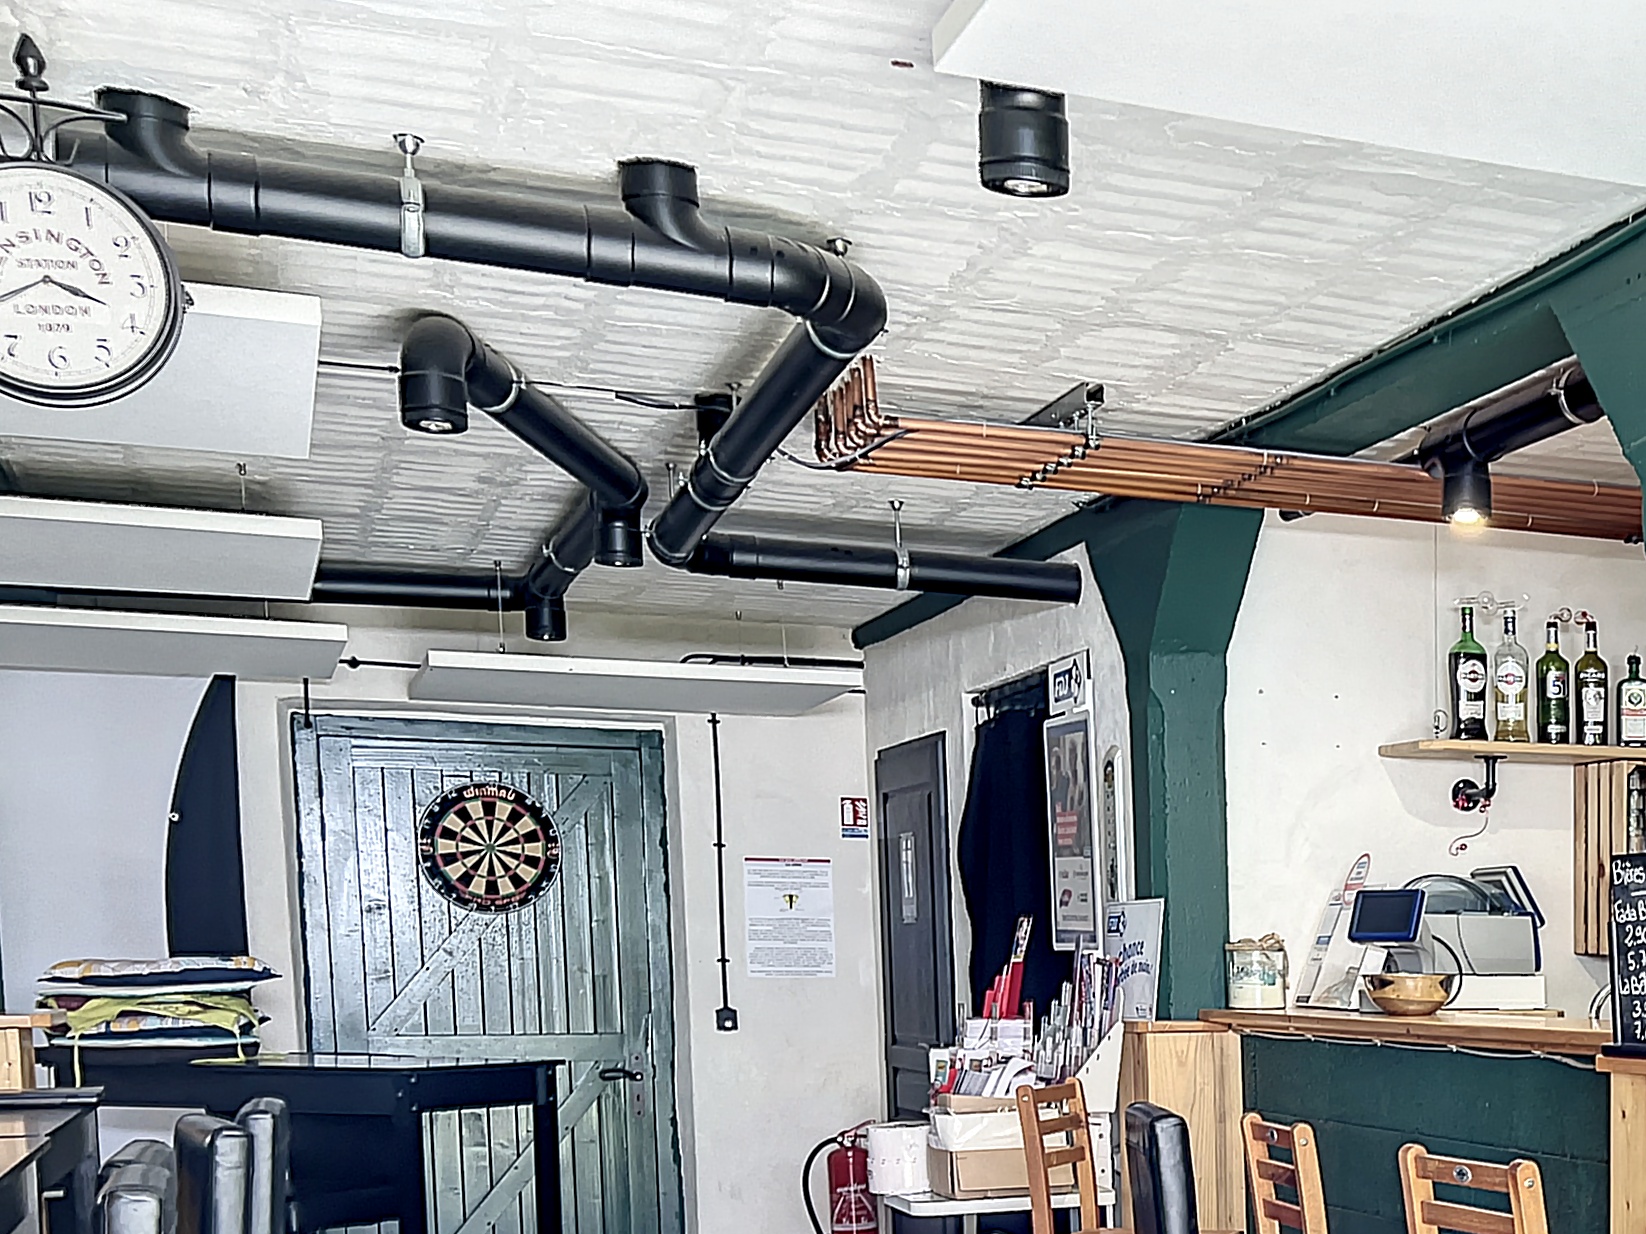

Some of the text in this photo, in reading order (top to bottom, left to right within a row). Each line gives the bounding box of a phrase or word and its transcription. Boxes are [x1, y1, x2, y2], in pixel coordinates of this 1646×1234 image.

[28, 190, 54, 215] 12
[84, 206, 93, 228] 1
[0, 228, 113, 286] NSINGTON
[112, 234, 131, 259] 2
[15, 258, 78, 271] STATION
[129, 274, 147, 299] 3
[13, 303, 91, 317] LONDON
[48, 345, 71, 370] 6
